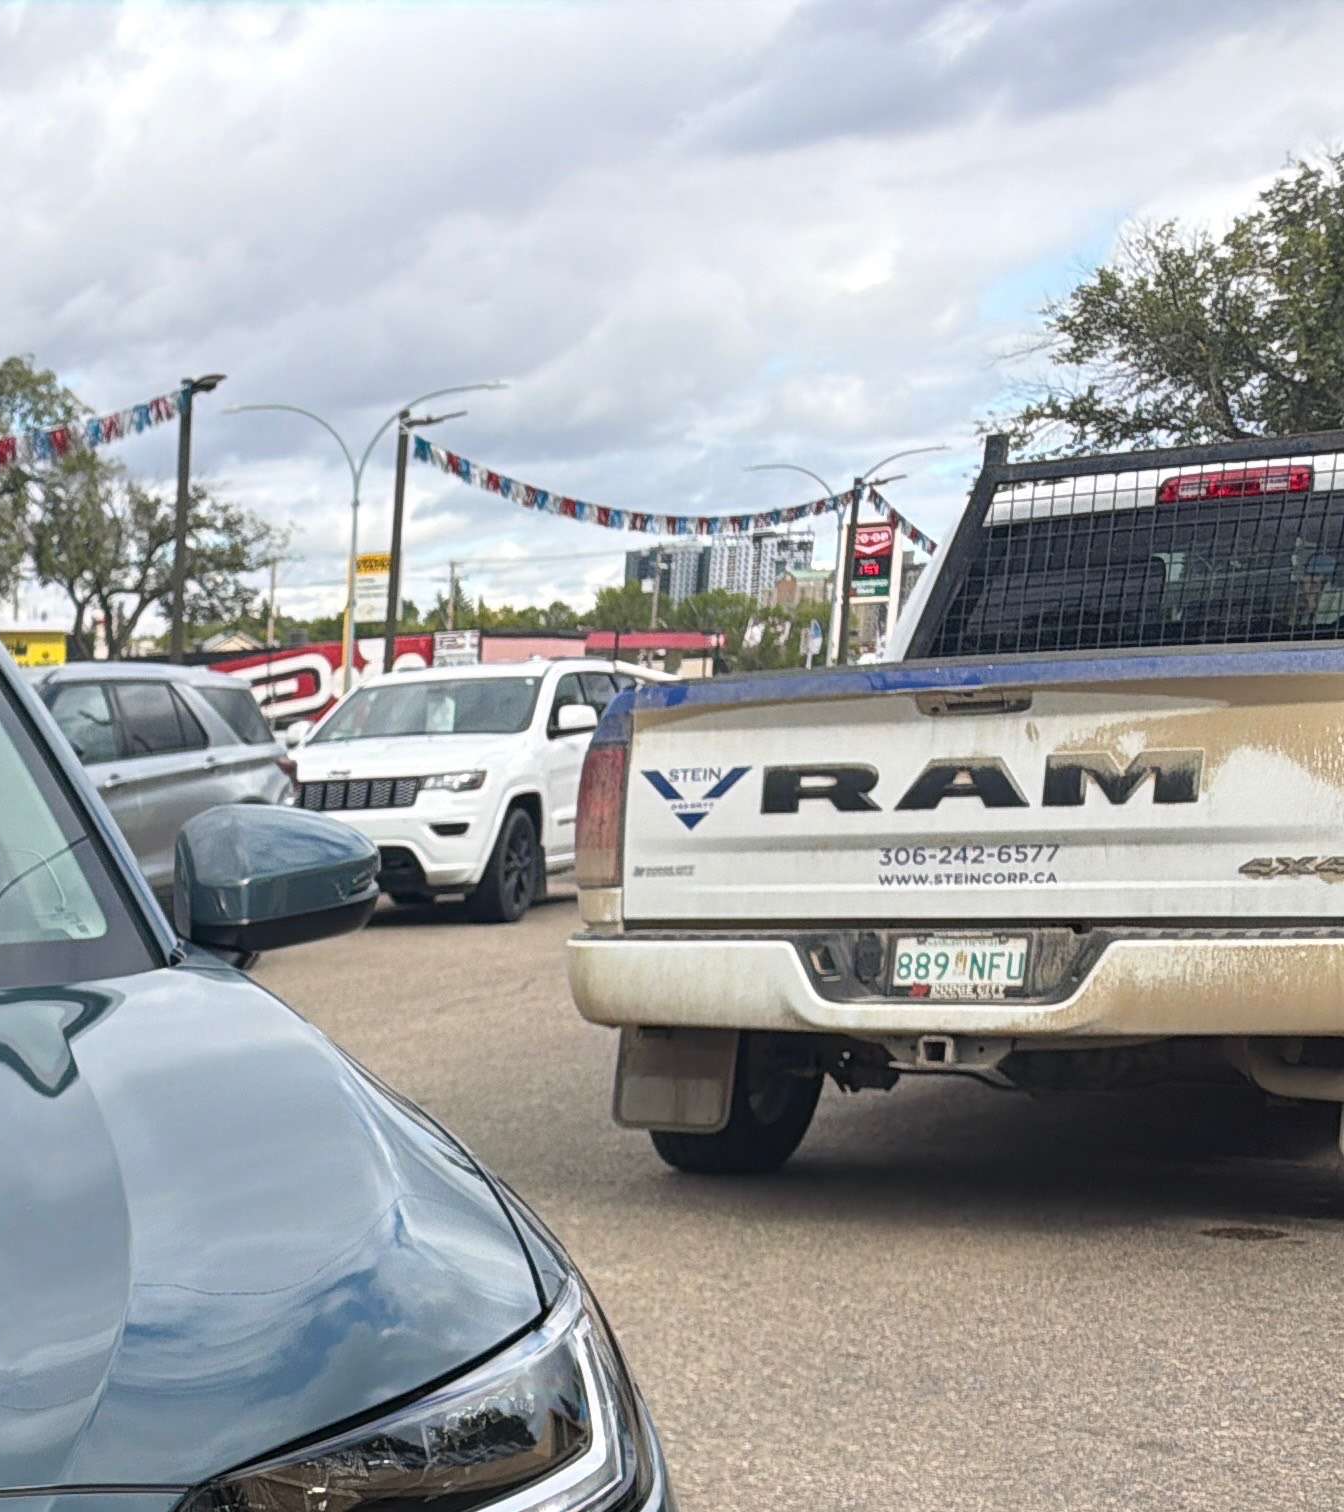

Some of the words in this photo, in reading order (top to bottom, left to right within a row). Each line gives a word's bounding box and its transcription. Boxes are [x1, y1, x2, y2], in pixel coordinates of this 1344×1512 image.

[668, 767, 722, 783] STEIN
[760, 748, 1206, 815] RAM
[878, 844, 1061, 867] 306-242-6577
[878, 871, 1058, 886] WWW.STEINCORP.CA
[897, 952, 950, 980] 889
[968, 952, 1025, 981] NFU
